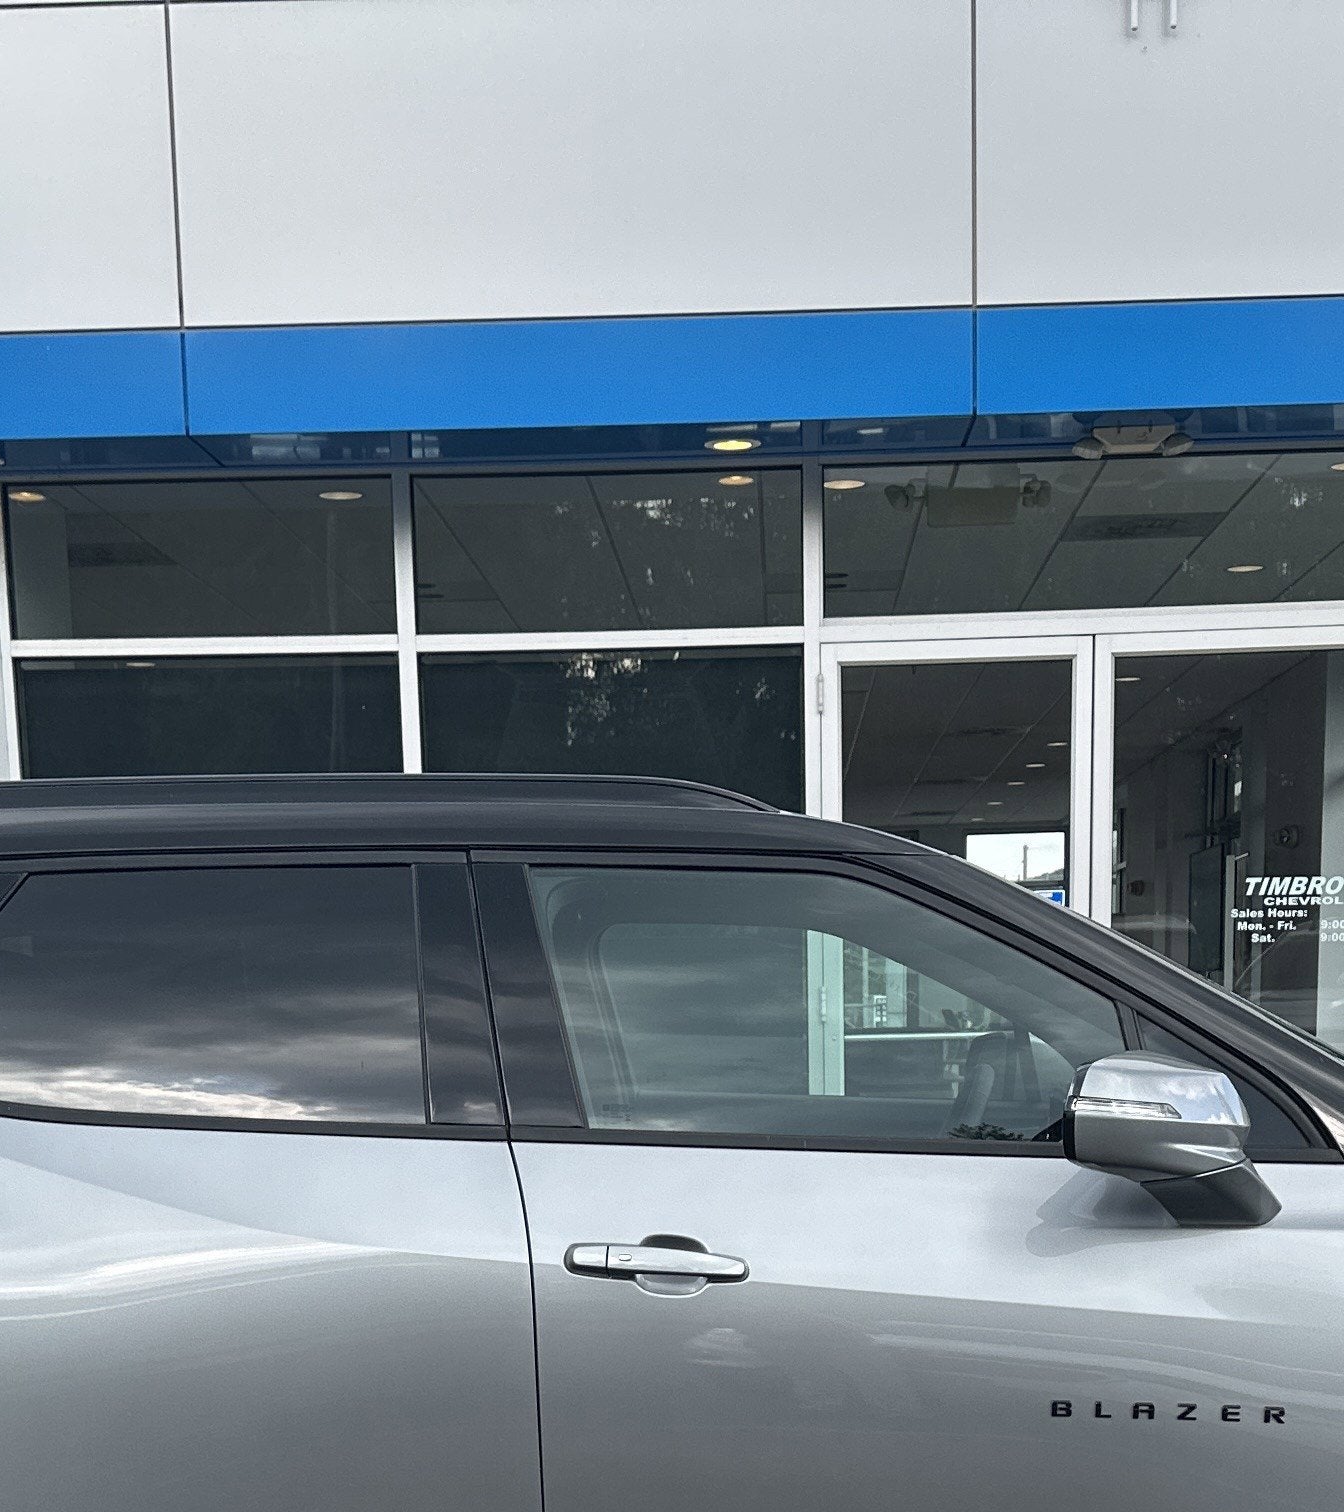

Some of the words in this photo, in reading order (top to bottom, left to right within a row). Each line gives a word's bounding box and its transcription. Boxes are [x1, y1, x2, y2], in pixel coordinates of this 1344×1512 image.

[1231, 909, 1264, 918] Sales
[1268, 908, 1308, 918] Hours:
[1237, 921, 1266, 931] Mon.
[1277, 920, 1297, 931] Fri.
[1251, 934, 1275, 943] Sat.
[1051, 1400, 1286, 1424] BLAZER
